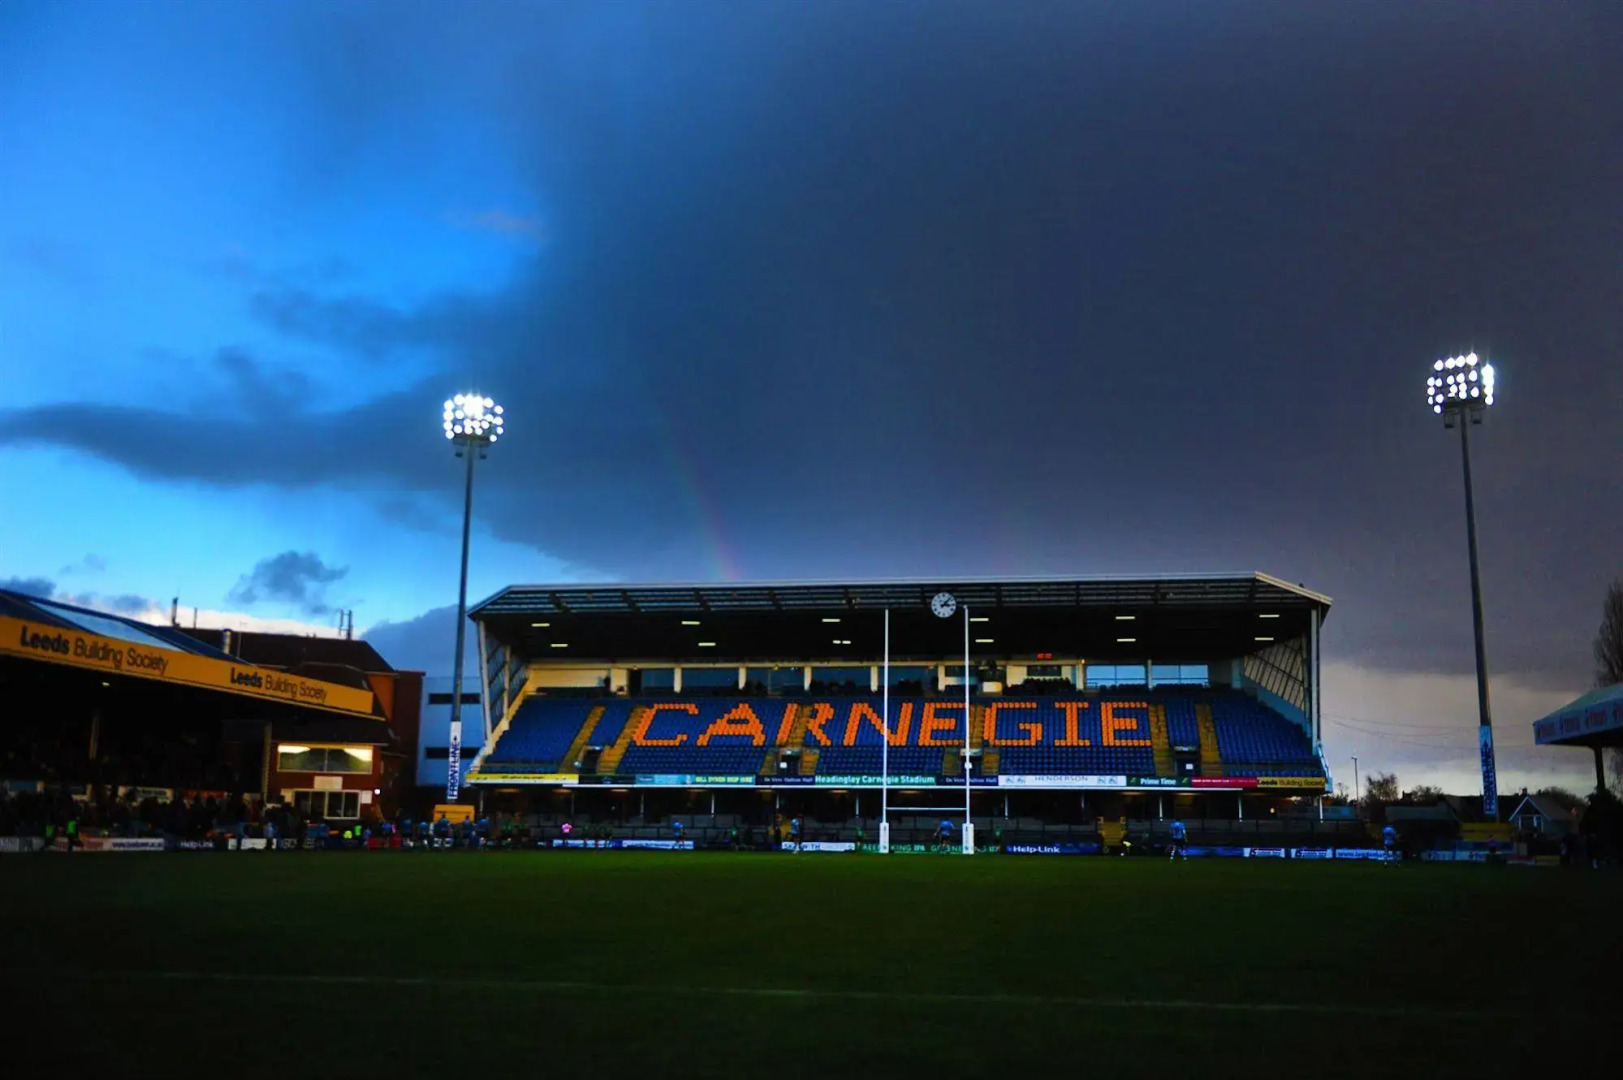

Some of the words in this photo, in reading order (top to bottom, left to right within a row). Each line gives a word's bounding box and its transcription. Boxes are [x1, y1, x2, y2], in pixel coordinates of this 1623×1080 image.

[20, 625, 70, 655] Leeds
[74, 637, 123, 669] Building
[126, 648, 168, 676] Society
[231, 668, 263, 687] Leeds
[265, 675, 299, 698] Building
[299, 682, 329, 703] Society
[632, 701, 1154, 748] CARNEGIE
[816, 775, 860, 784] Headingley
[900, 775, 936, 783] Stadium
